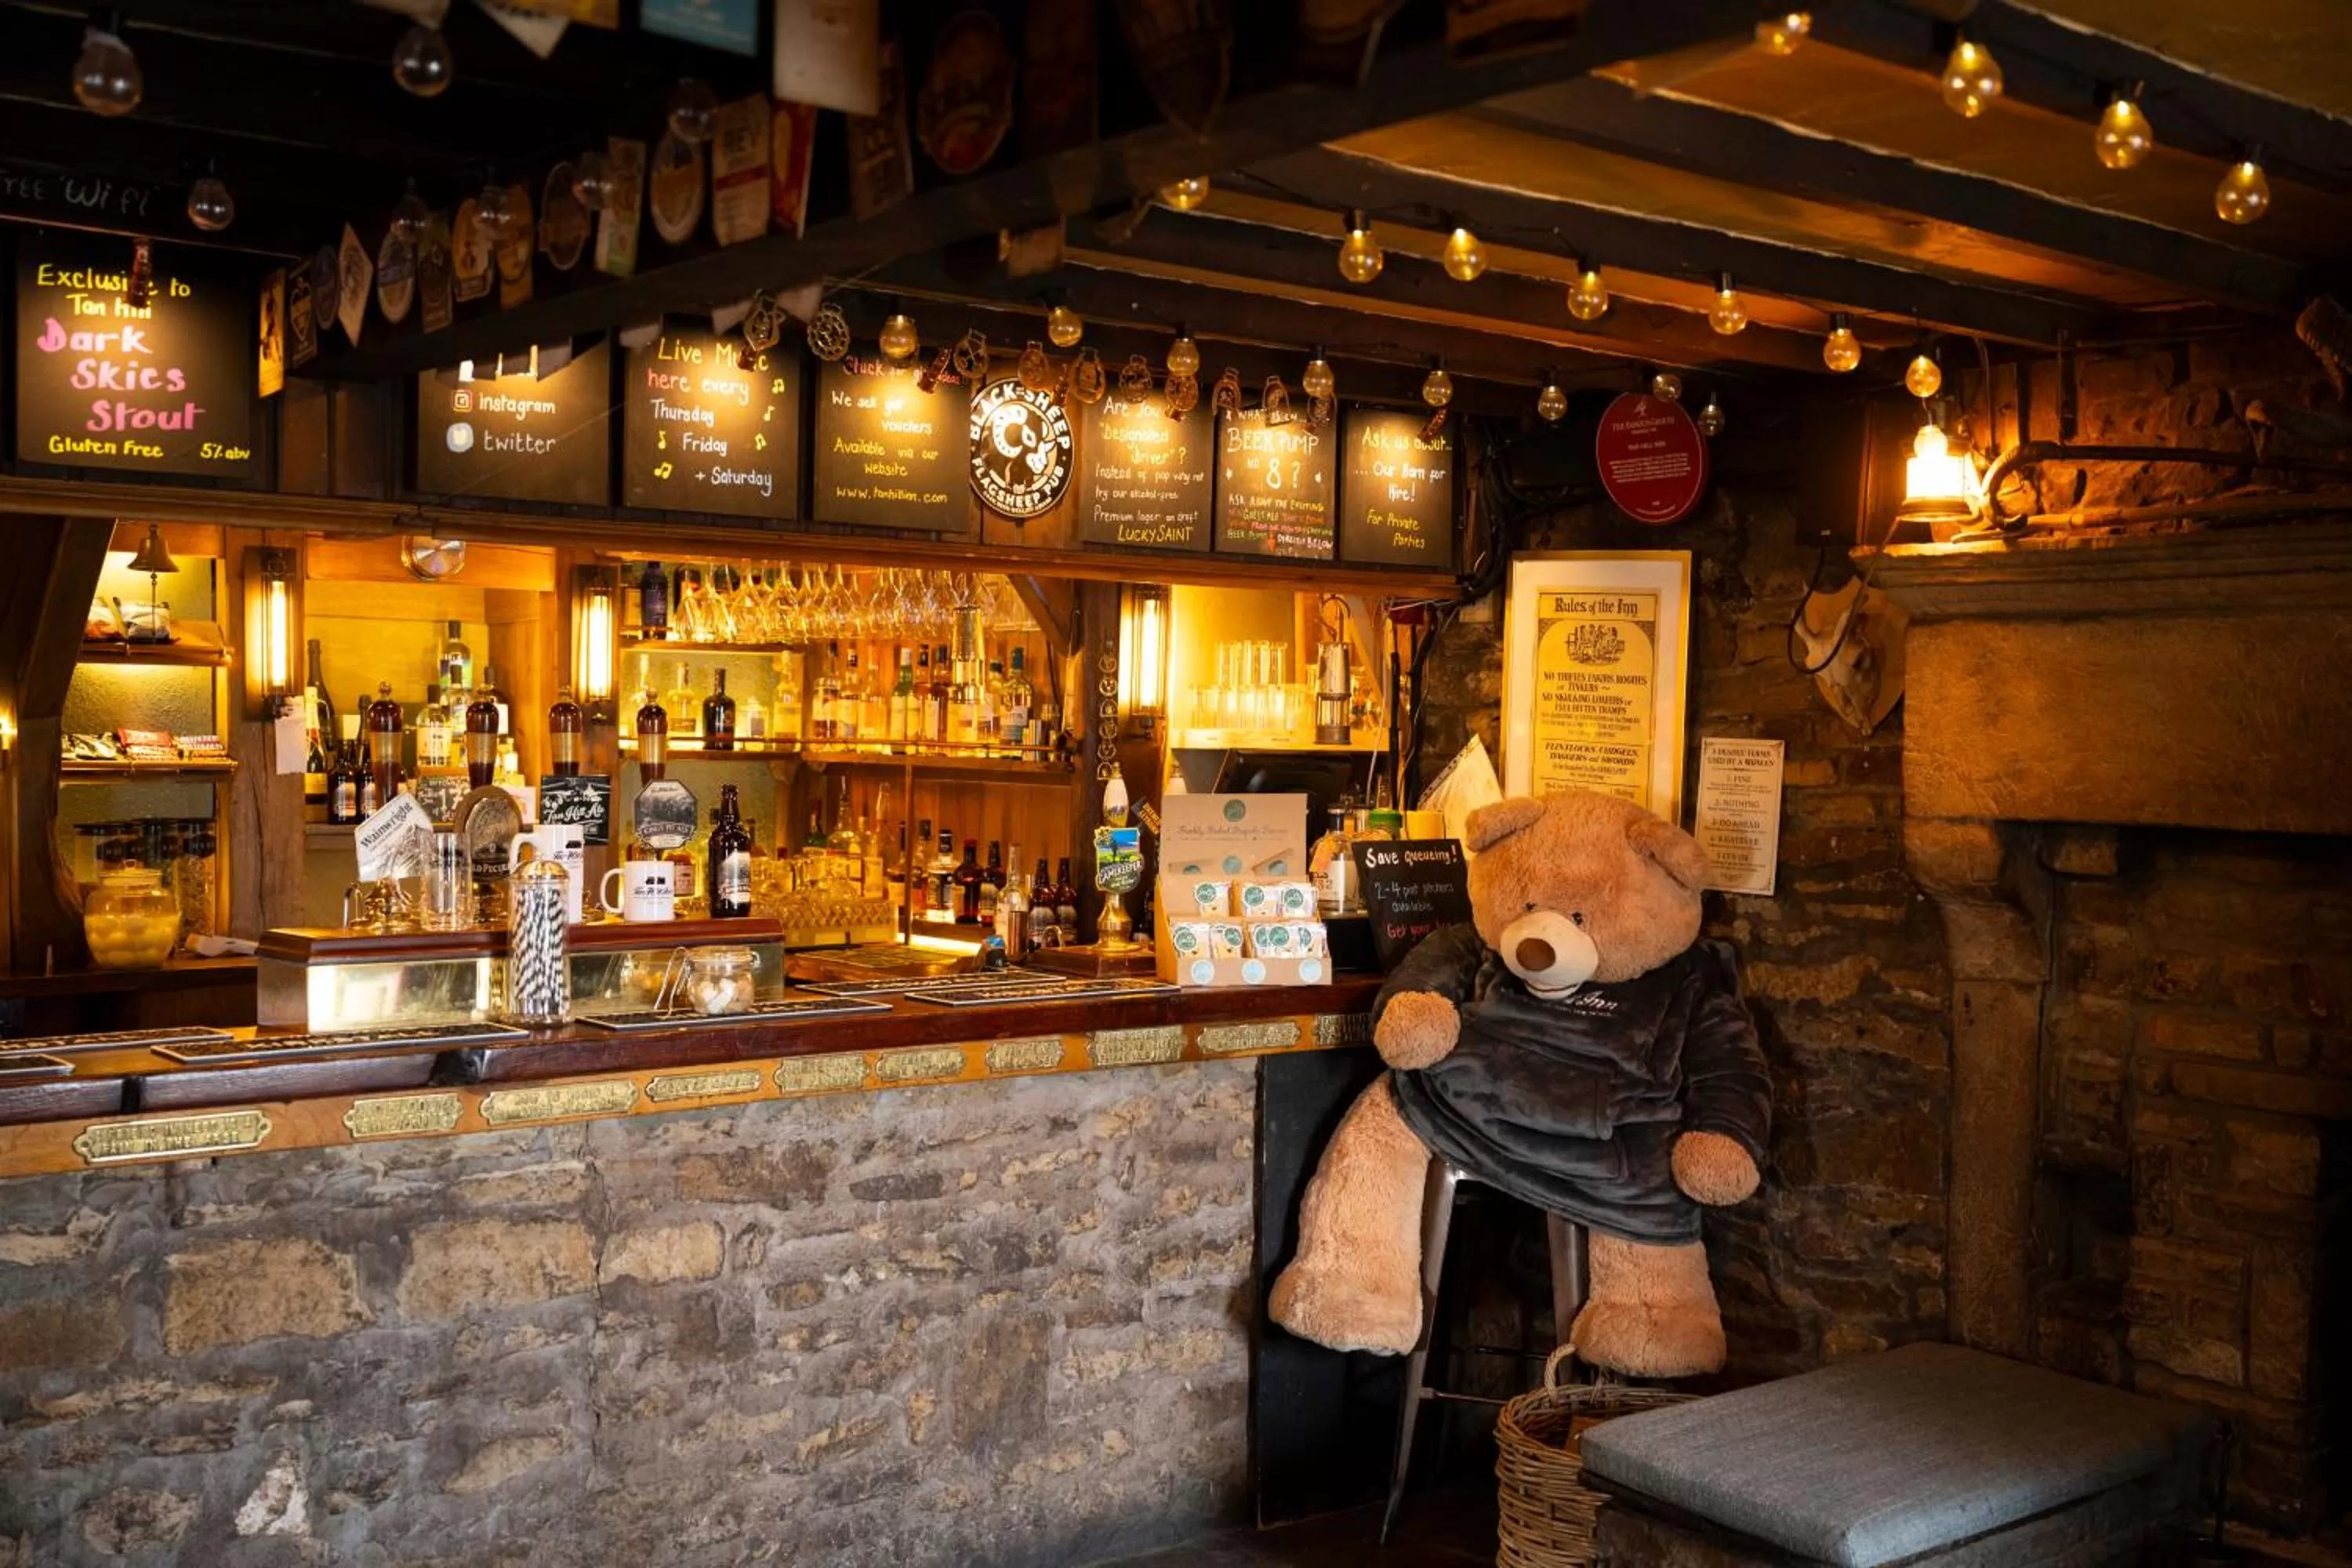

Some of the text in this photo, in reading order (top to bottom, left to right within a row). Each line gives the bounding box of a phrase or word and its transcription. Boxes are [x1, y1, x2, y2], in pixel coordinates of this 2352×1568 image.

[37, 263, 191, 297] Exclusi to
[66, 293, 106, 316] Tan
[37, 317, 154, 354] Dark
[659, 338, 768, 371] Live Muc
[70, 358, 186, 392] Skies
[648, 367, 750, 405] here every
[479, 393, 557, 420] Instagram
[832, 390, 852, 408] We
[1103, 396, 1130, 417] Are
[86, 400, 206, 432] Stout
[650, 397, 714, 427] Thursday
[970, 383, 1070, 449] BLACK SHEEP
[49, 435, 117, 456] Gluten
[123, 439, 164, 458] Free
[484, 432, 556, 455] twitter
[682, 432, 728, 457] Friday
[834, 437, 939, 460] Available via our
[1227, 427, 1319, 458] BEER PUMP
[1362, 426, 1391, 448] Ask
[1395, 435, 1410, 450] us
[711, 466, 772, 496] Saturday
[1044, 466, 1064, 495] PUB
[1095, 464, 1204, 485] Instead of pop why not
[1266, 456, 1281, 489] 8
[1374, 461, 1397, 477] Our
[1112, 490, 1128, 499] our
[1094, 505, 1134, 522] Premium
[1138, 509, 1161, 524] lager
[1367, 509, 1421, 530] For Private
[1117, 524, 1194, 543] LUCKY SAINT
[1393, 532, 1425, 549] Parties
[1555, 597, 1639, 616] Rules of the Inn
[360, 802, 414, 848] Wainwright
[1365, 848, 1399, 868] Save
